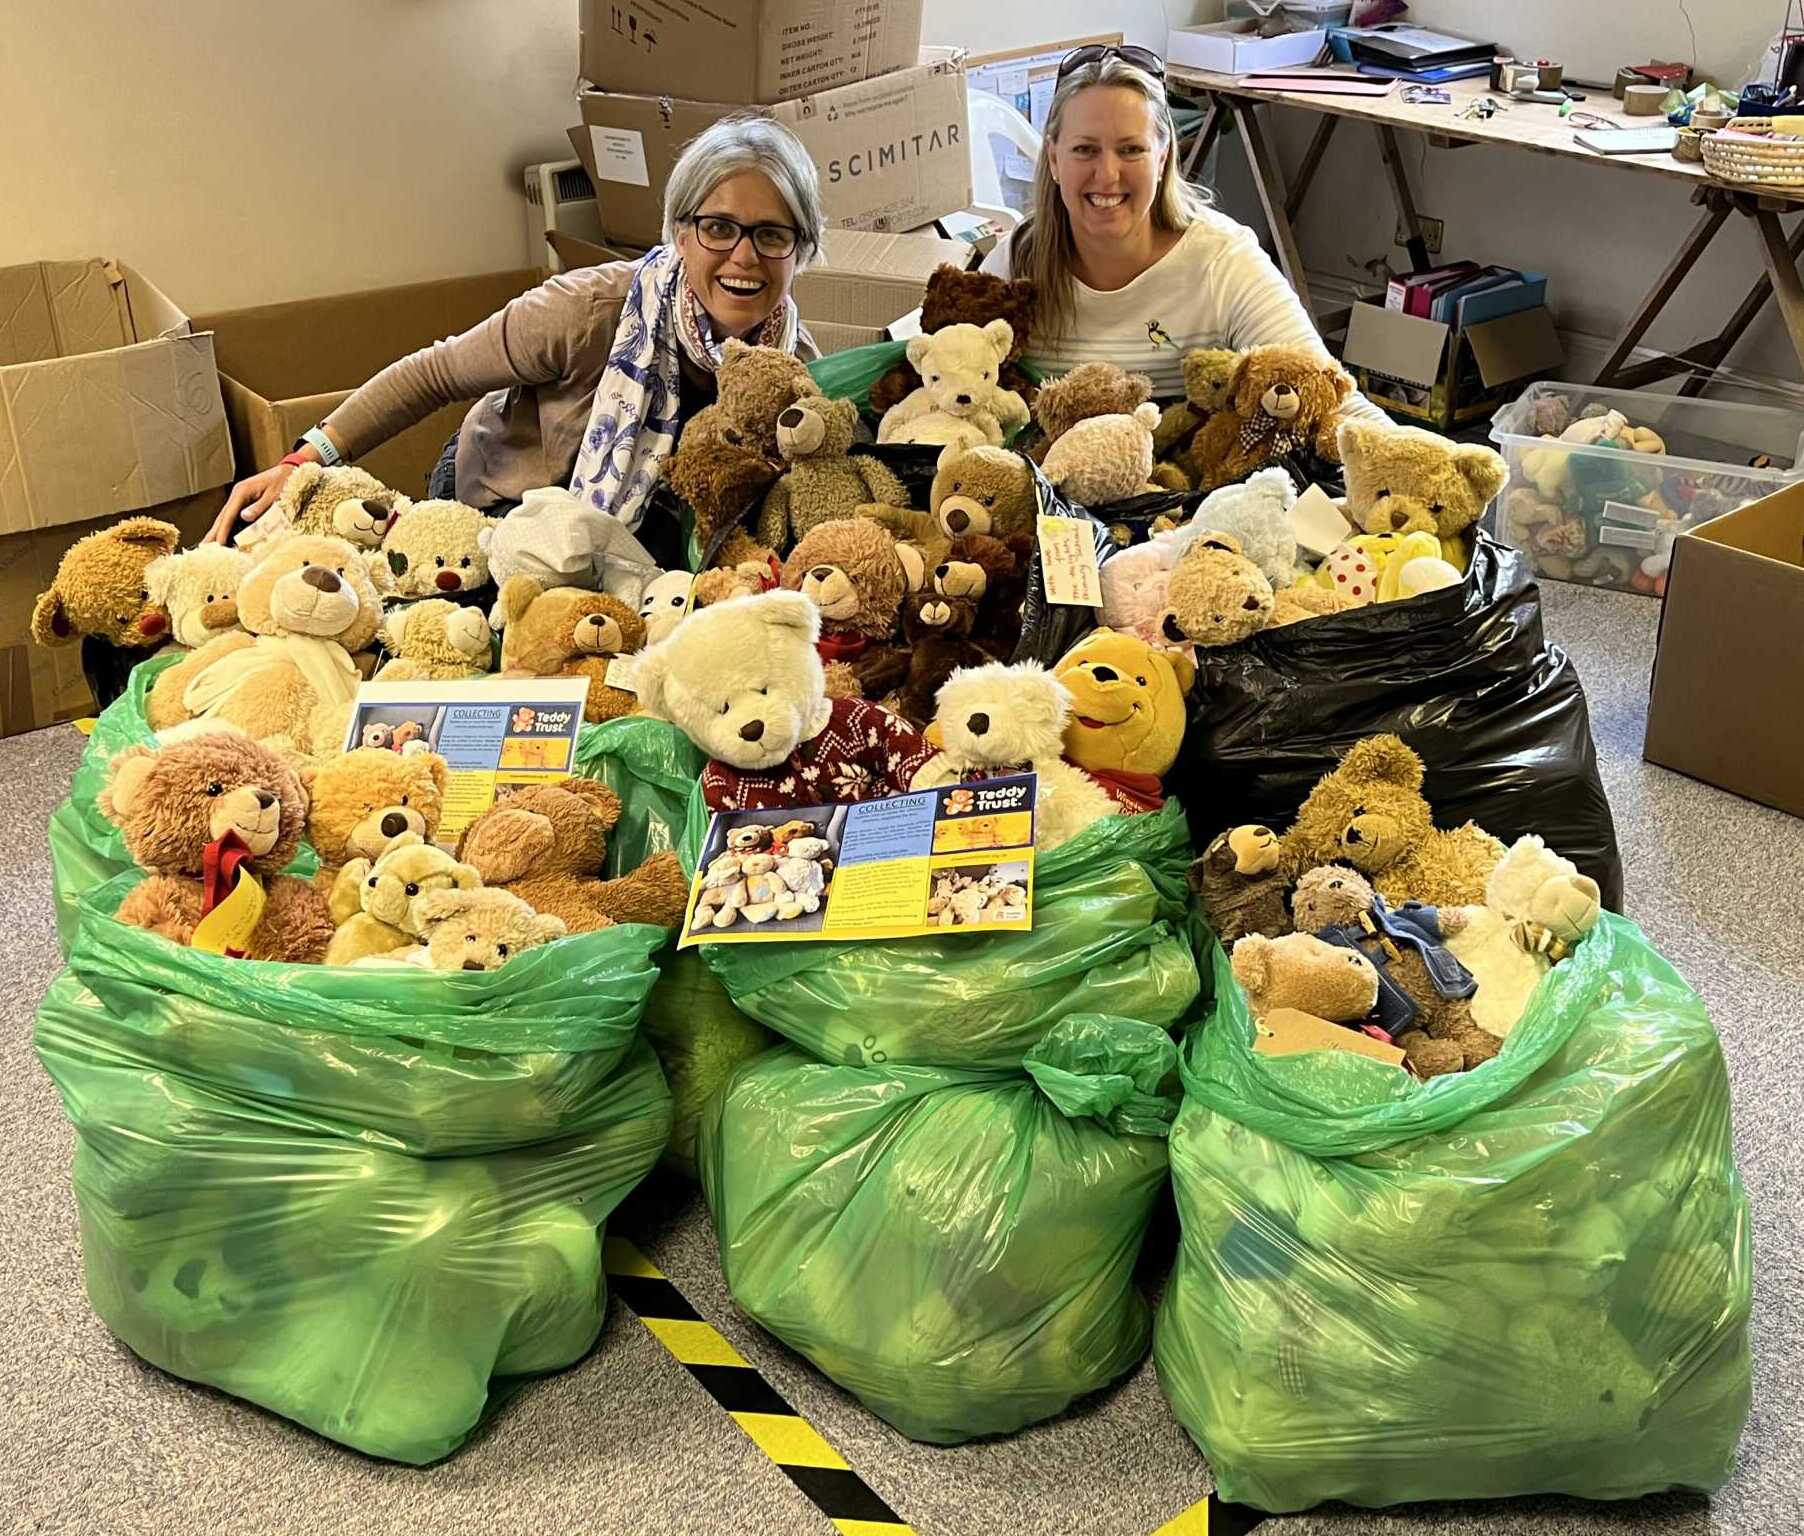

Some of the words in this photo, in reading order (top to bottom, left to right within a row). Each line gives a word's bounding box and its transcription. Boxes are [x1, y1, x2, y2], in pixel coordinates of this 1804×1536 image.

[802, 61, 829, 75] CARTON
[803, 75, 829, 89] CARTON
[828, 124, 960, 183] SCIMITAR
[453, 709, 501, 720] COLLECTING
[537, 712, 571, 724] Teddy
[977, 786, 1027, 800] Teddy
[858, 796, 927, 815] COLLECTING
